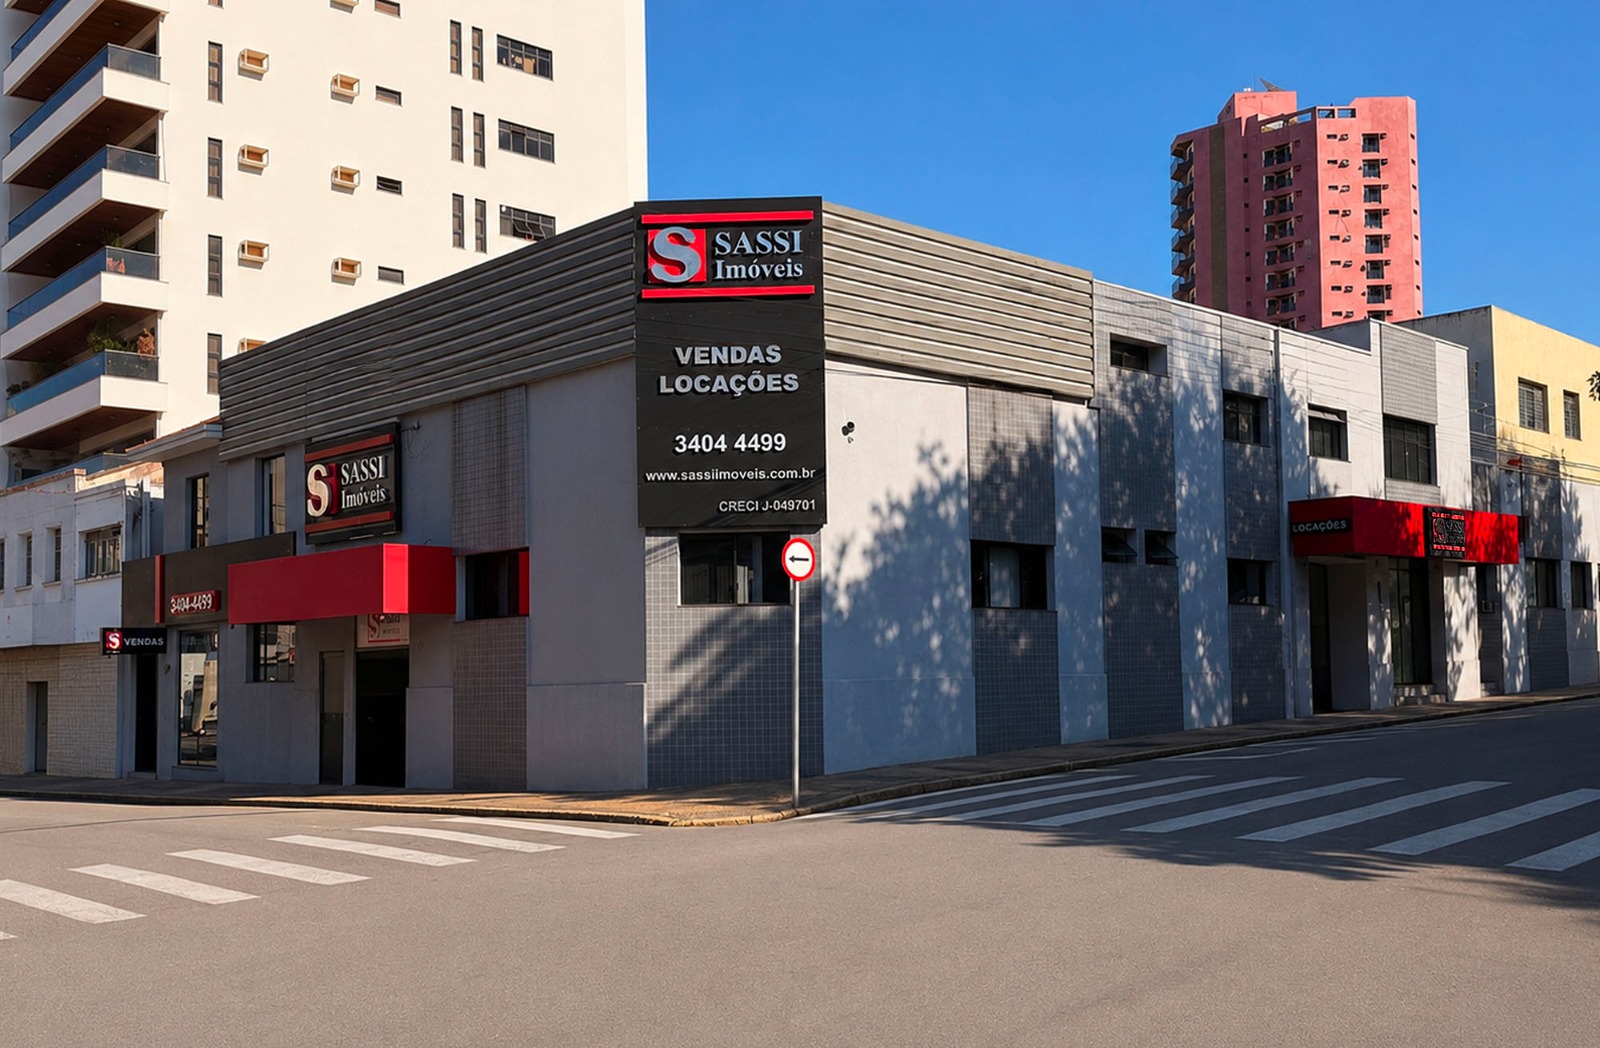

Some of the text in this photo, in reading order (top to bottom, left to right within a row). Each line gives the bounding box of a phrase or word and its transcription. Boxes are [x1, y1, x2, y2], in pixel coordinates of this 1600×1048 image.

[714, 230, 803, 255] SASSI
[651, 226, 701, 283] S
[714, 258, 803, 279] Imóveis
[675, 345, 782, 364] VENDAS
[659, 370, 799, 397] LOCAÇÕES
[674, 433, 786, 452] 3404 4499
[341, 455, 386, 486] SASSI
[645, 467, 816, 481] www.sassiimoveis.com.br
[341, 484, 387, 509] Imóveis
[719, 499, 816, 512] CRECI J-049701
[123, 637, 165, 646] VENDAS
